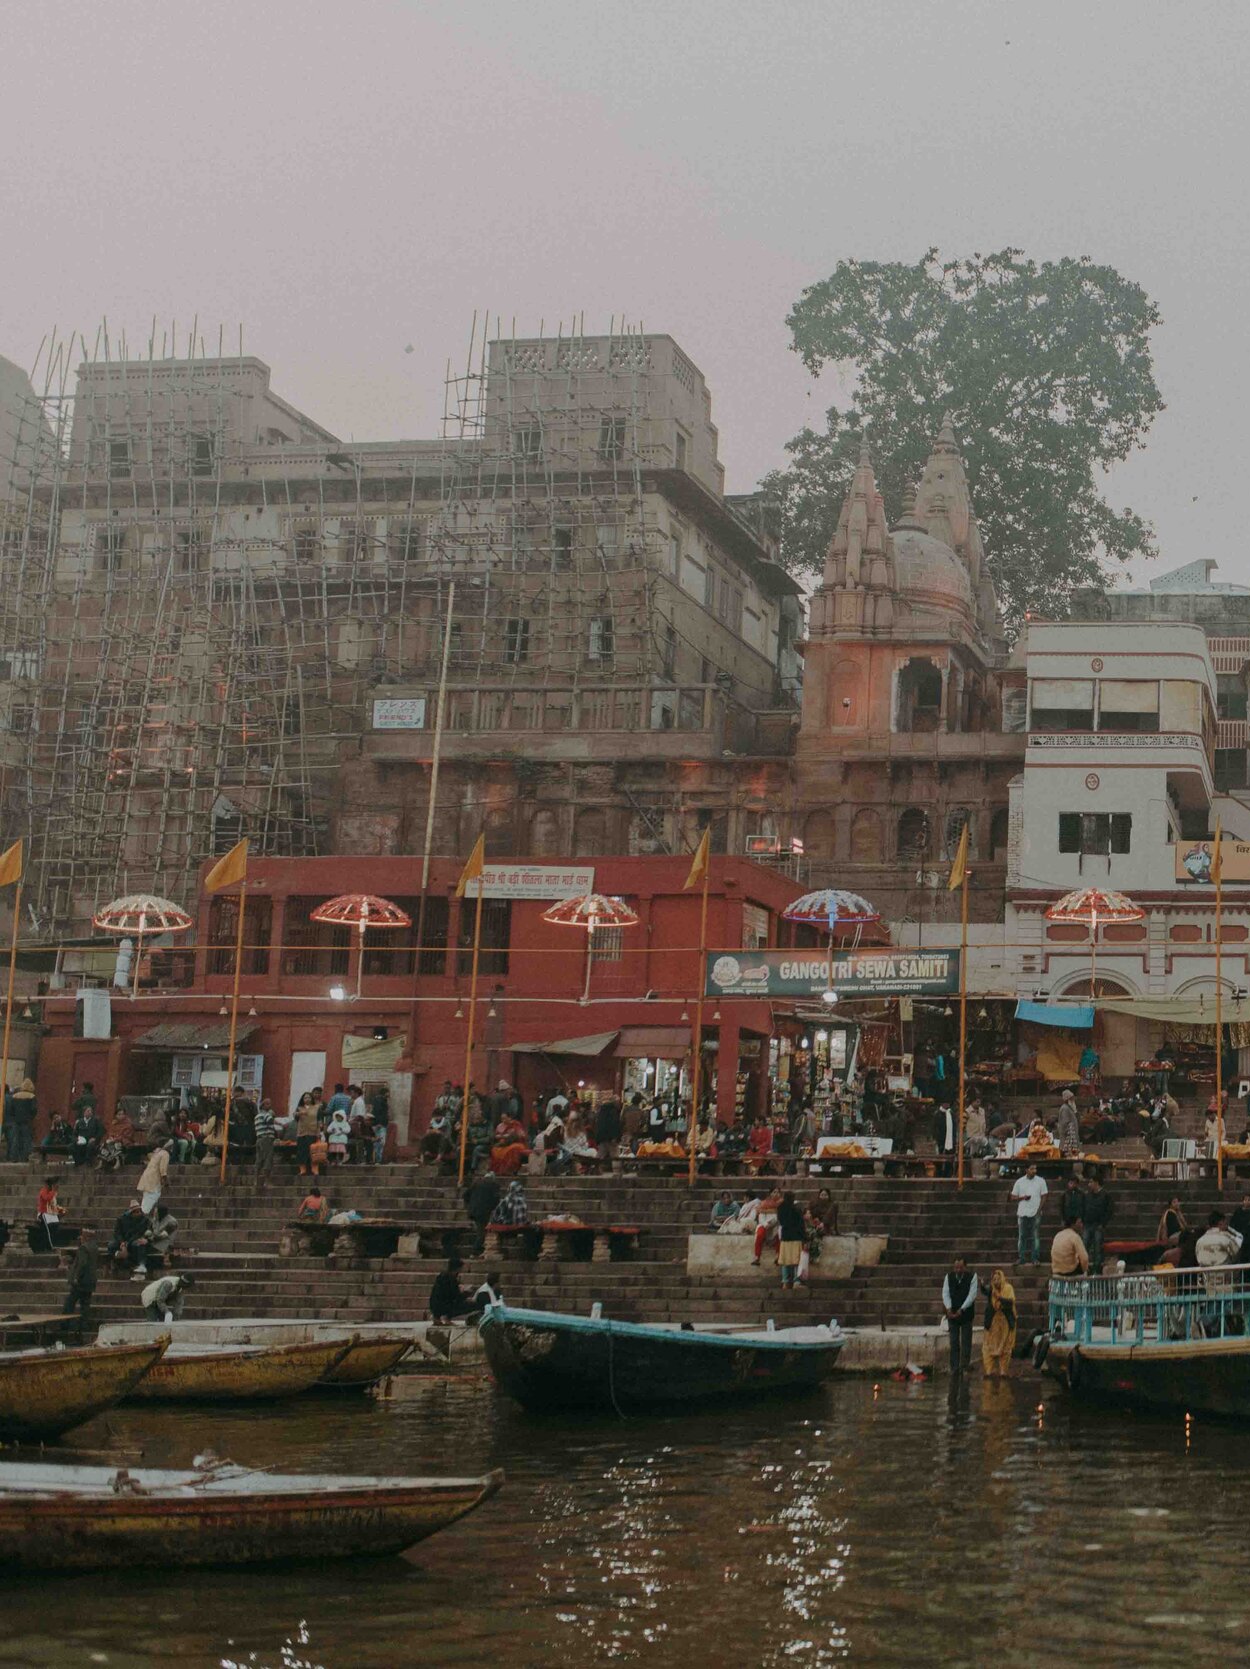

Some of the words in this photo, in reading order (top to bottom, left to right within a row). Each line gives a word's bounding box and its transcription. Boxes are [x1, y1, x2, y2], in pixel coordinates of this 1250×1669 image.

[779, 960, 852, 980] GANGOTRI
[856, 959, 896, 979] SEWA
[899, 959, 946, 978] SAMITI
